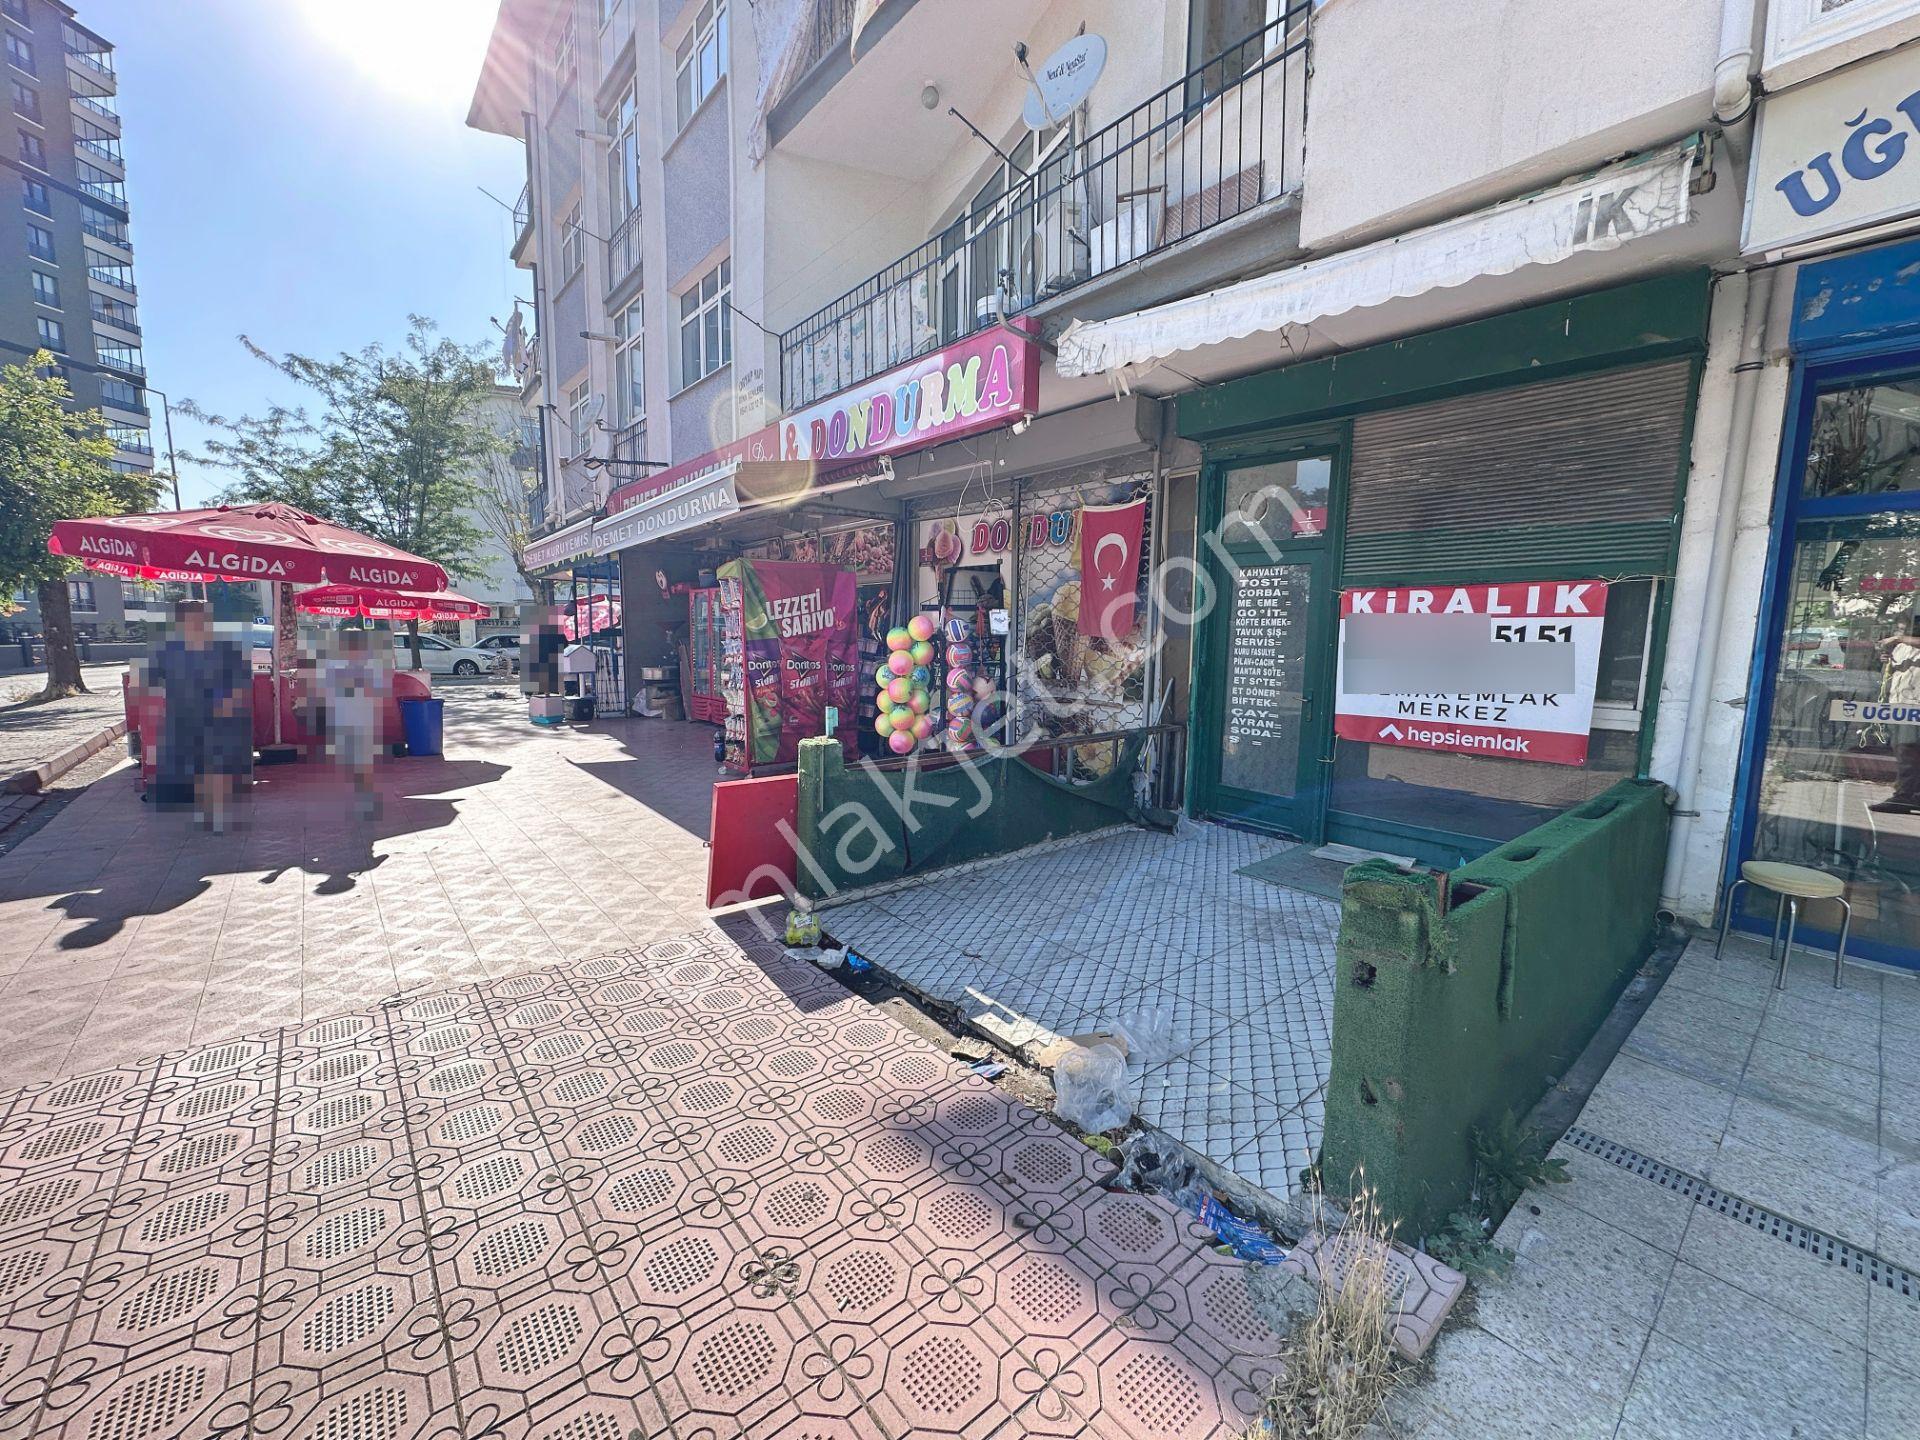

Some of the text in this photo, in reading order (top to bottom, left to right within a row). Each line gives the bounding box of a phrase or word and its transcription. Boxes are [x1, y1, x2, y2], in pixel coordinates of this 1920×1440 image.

[1775, 90, 1920, 217] UĞ
[810, 344, 1013, 460] DONDURMA
[595, 524, 633, 548] DEMET
[637, 487, 732, 535] DONDURMA
[766, 588, 822, 621] LEZZETİ
[1235, 617, 1259, 626] KÖFTE
[1235, 628, 1264, 636] TAVUK
[786, 659, 821, 670] Doritos
[1233, 666, 1261, 675] MANTAR
[1233, 676, 1247, 685] ET
[1232, 687, 1244, 695] ET
[1398, 701, 1508, 722] MERKEZ
[1407, 726, 1531, 753] hepsiemlak
